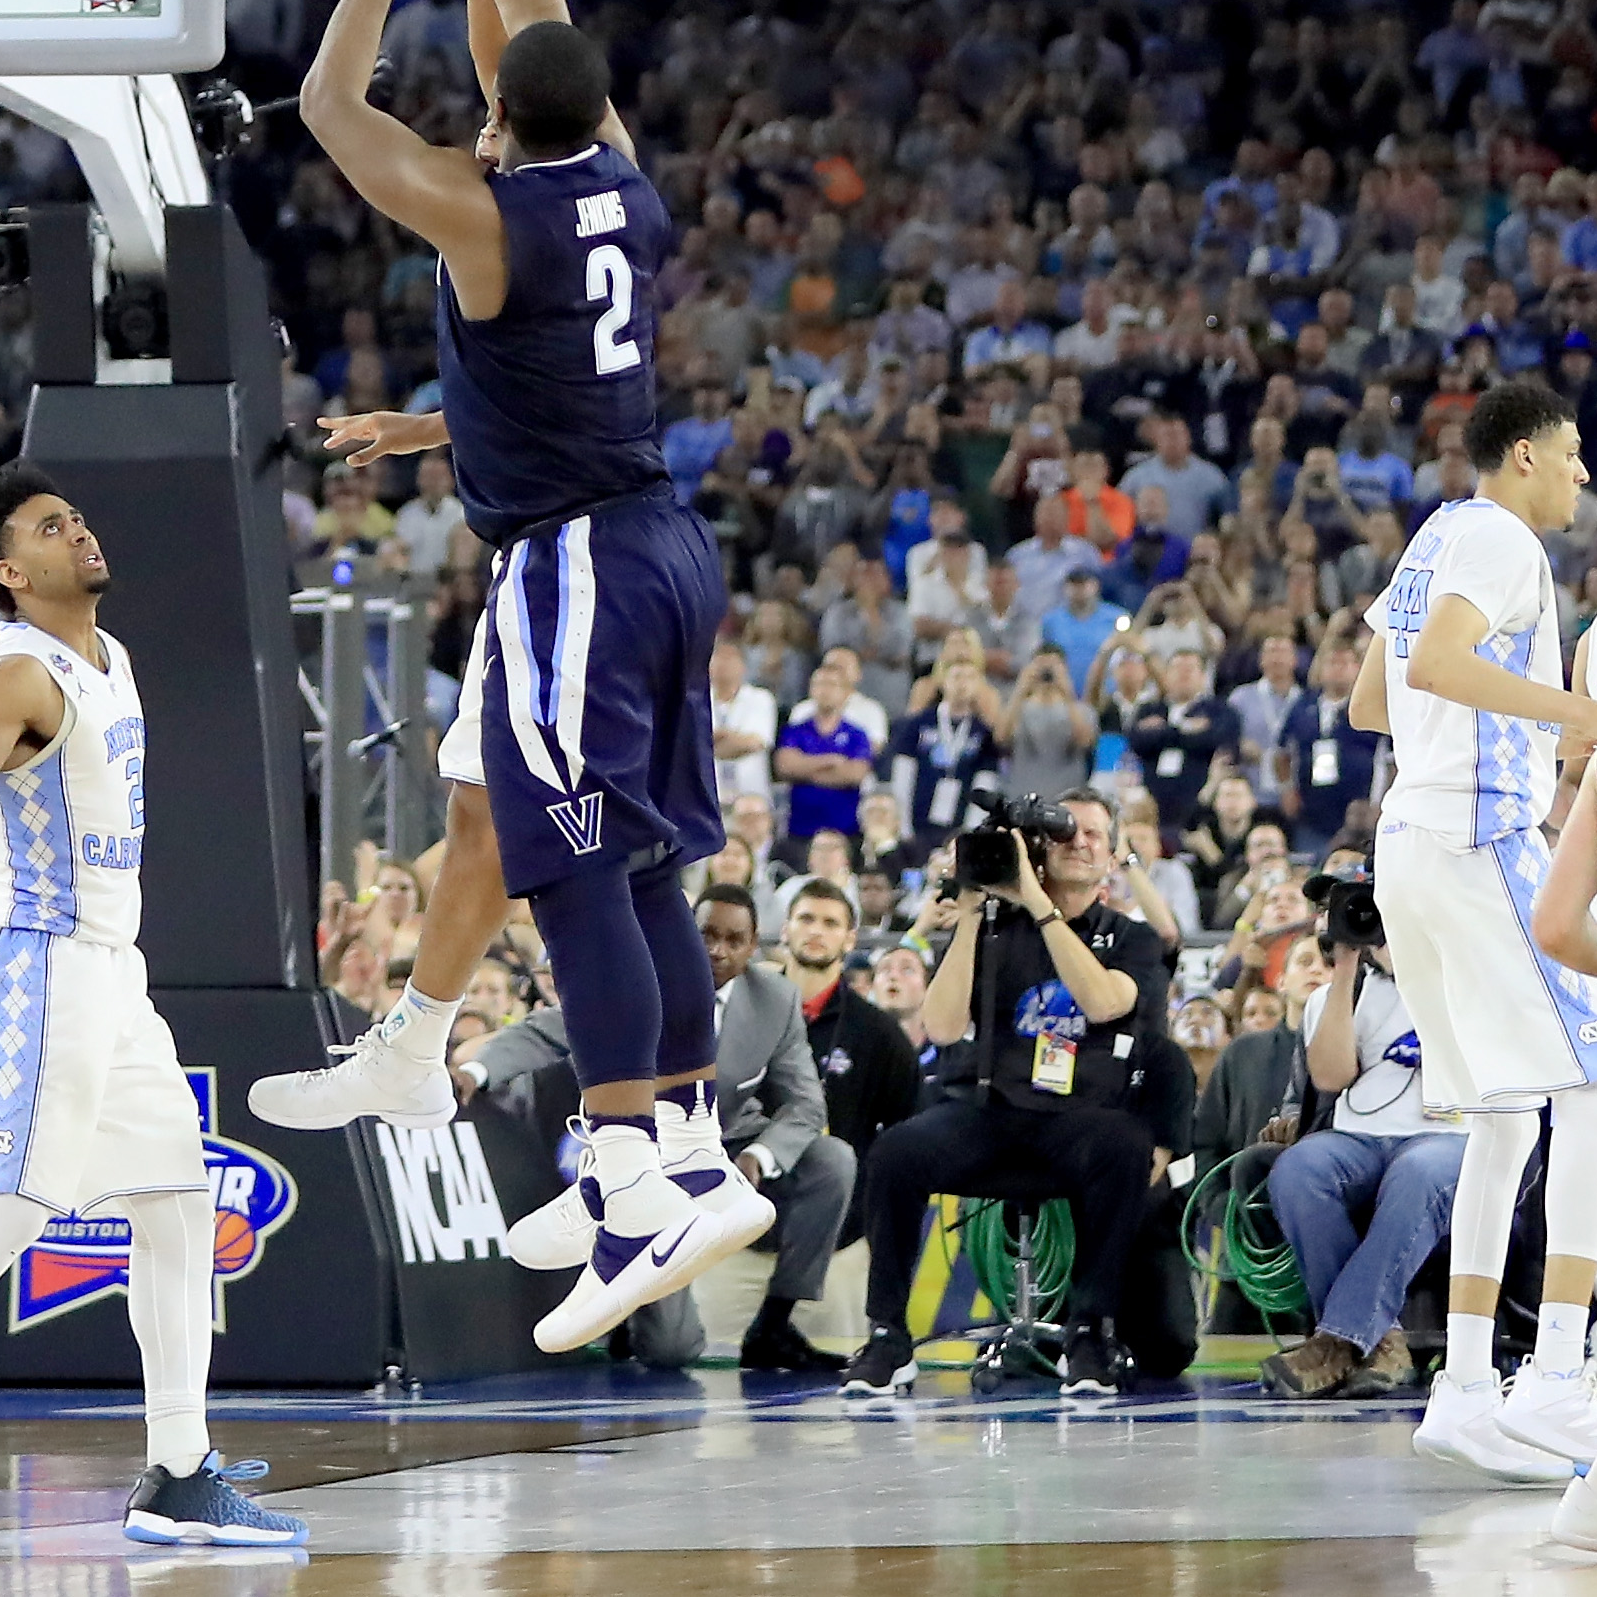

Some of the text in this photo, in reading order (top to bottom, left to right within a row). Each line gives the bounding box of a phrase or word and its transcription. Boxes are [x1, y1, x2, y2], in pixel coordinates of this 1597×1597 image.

[575, 190, 628, 239] JENKINS
[586, 245, 642, 376] 2
[1091, 933, 1115, 949] 21
[375, 1121, 513, 1264] NCAA
